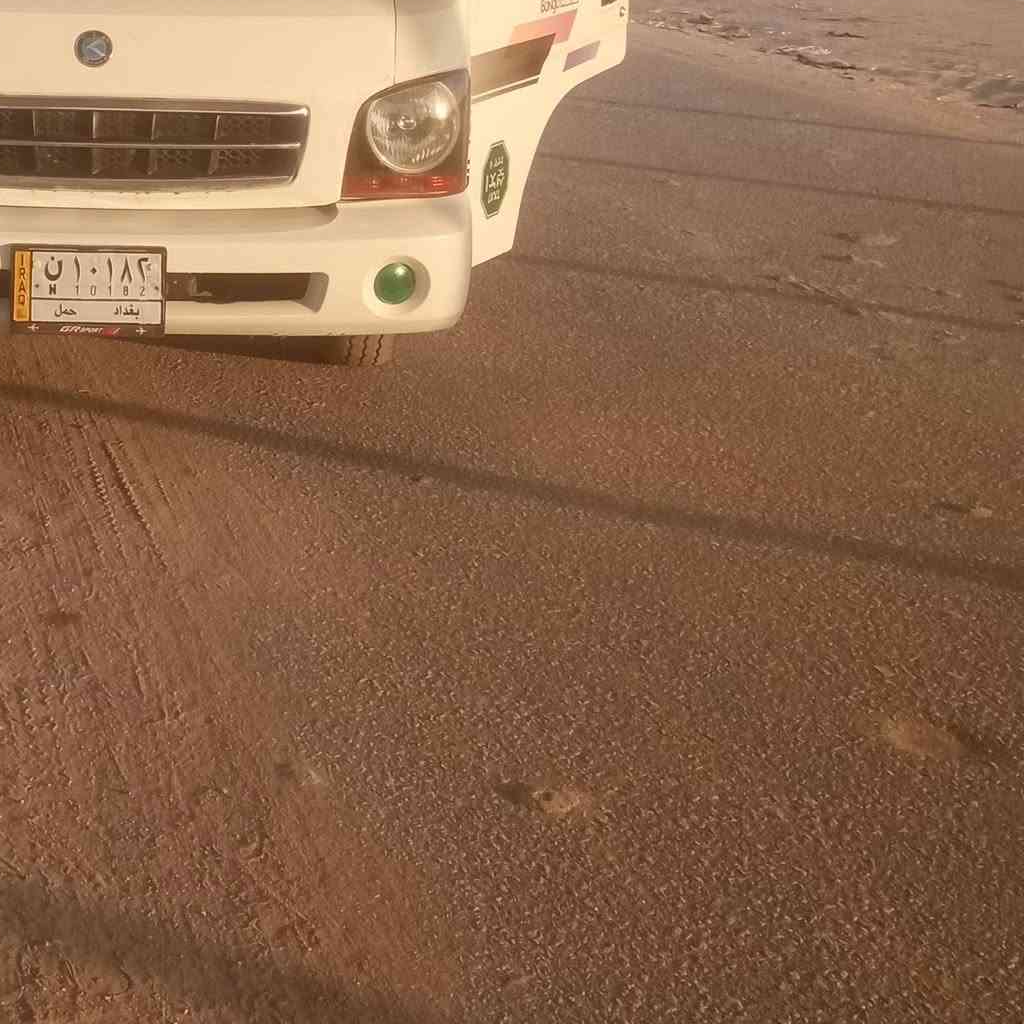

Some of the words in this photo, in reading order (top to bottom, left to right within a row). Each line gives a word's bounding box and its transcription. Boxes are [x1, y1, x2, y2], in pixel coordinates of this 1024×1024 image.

[17, 254, 26, 307] IRAQ
[54, 304, 77, 317] حمل
[114, 303, 140, 319] بغداد
